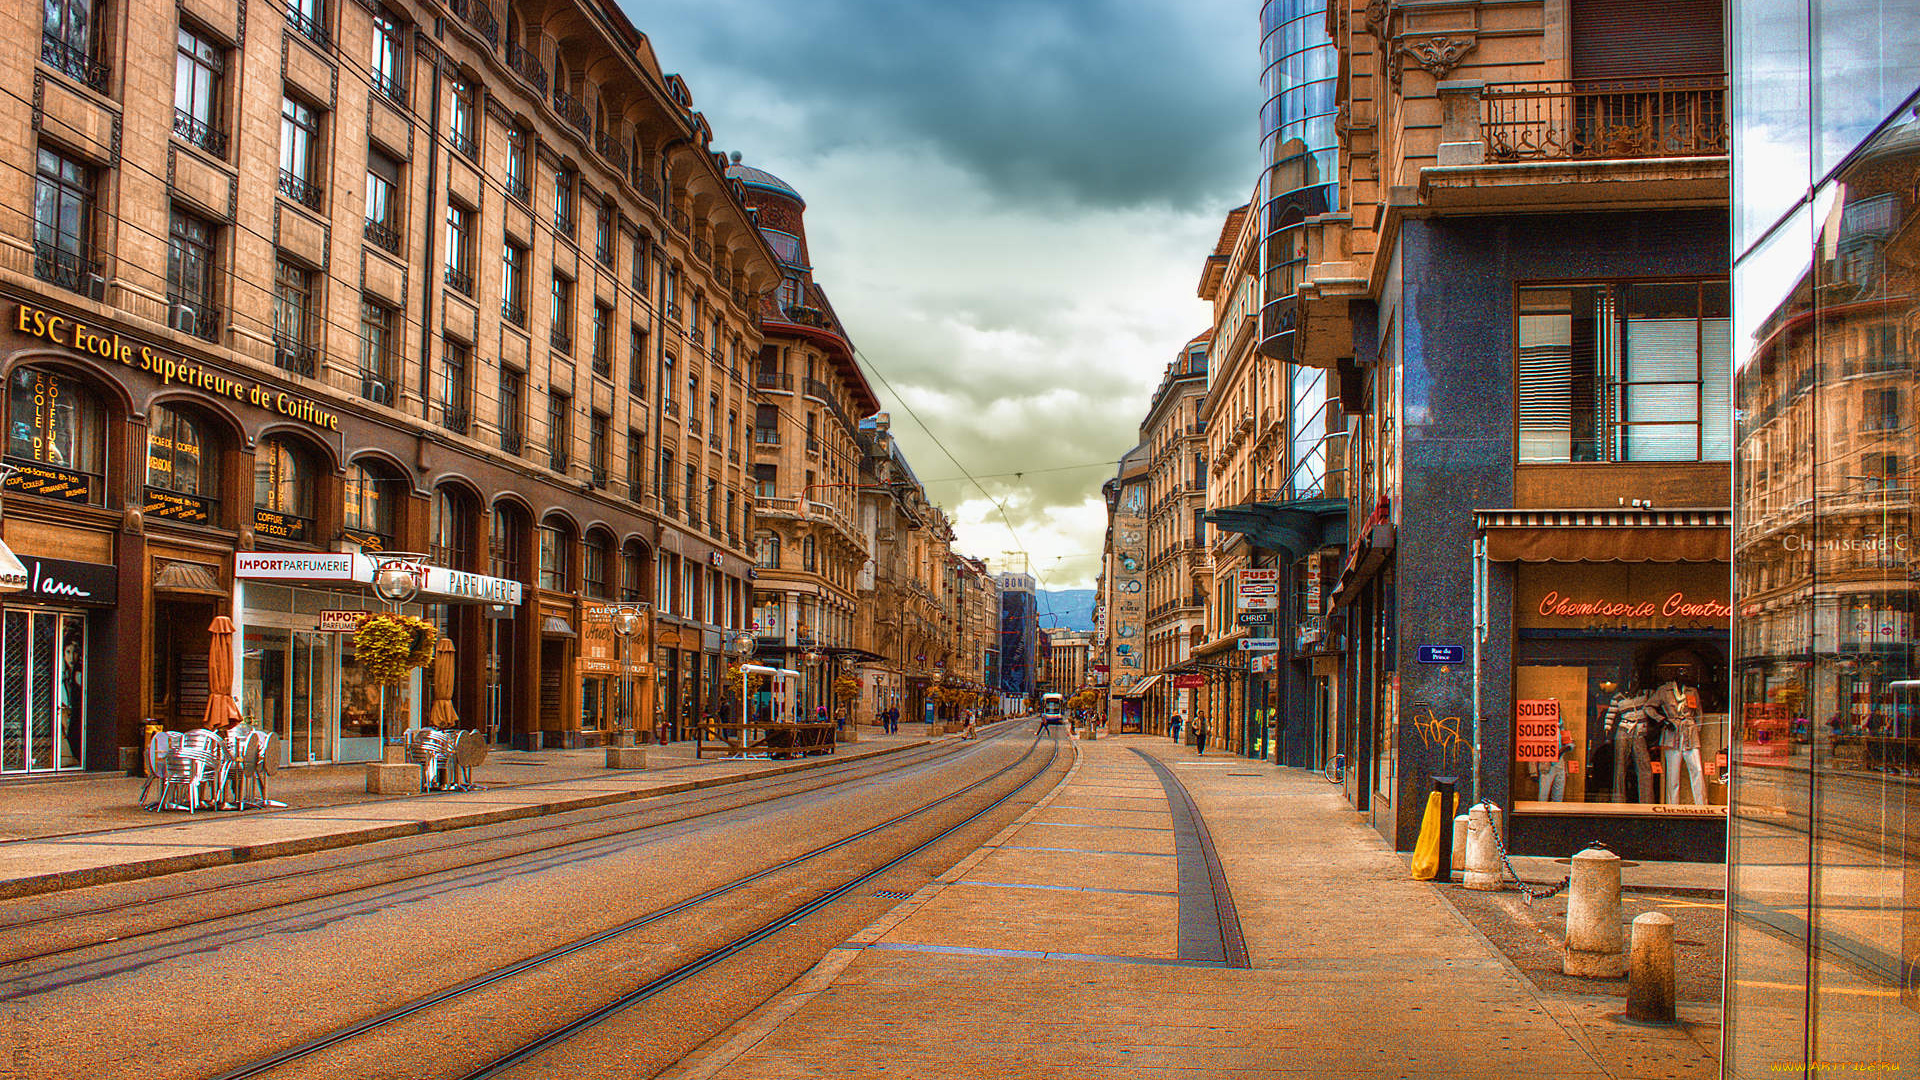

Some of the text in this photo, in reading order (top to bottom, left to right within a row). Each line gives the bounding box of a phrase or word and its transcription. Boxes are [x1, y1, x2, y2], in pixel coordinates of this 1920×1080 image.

[19, 304, 338, 430] ESC Ecole Supérieure de Coiffure
[33, 372, 45, 460] ECOLE DE
[48, 375, 58, 462] COIFFURE
[257, 511, 283, 525] COIFFURE
[269, 524, 287, 536] ECOLE
[449, 571, 514, 602] PARFUMERIE
[1539, 591, 1656, 618] Chemiserie
[1241, 614, 1267, 622] CHRIST
[1518, 703, 1557, 717] SOLDES
[1518, 723, 1557, 737] SOLDES
[1518, 744, 1557, 758] SOLDES
